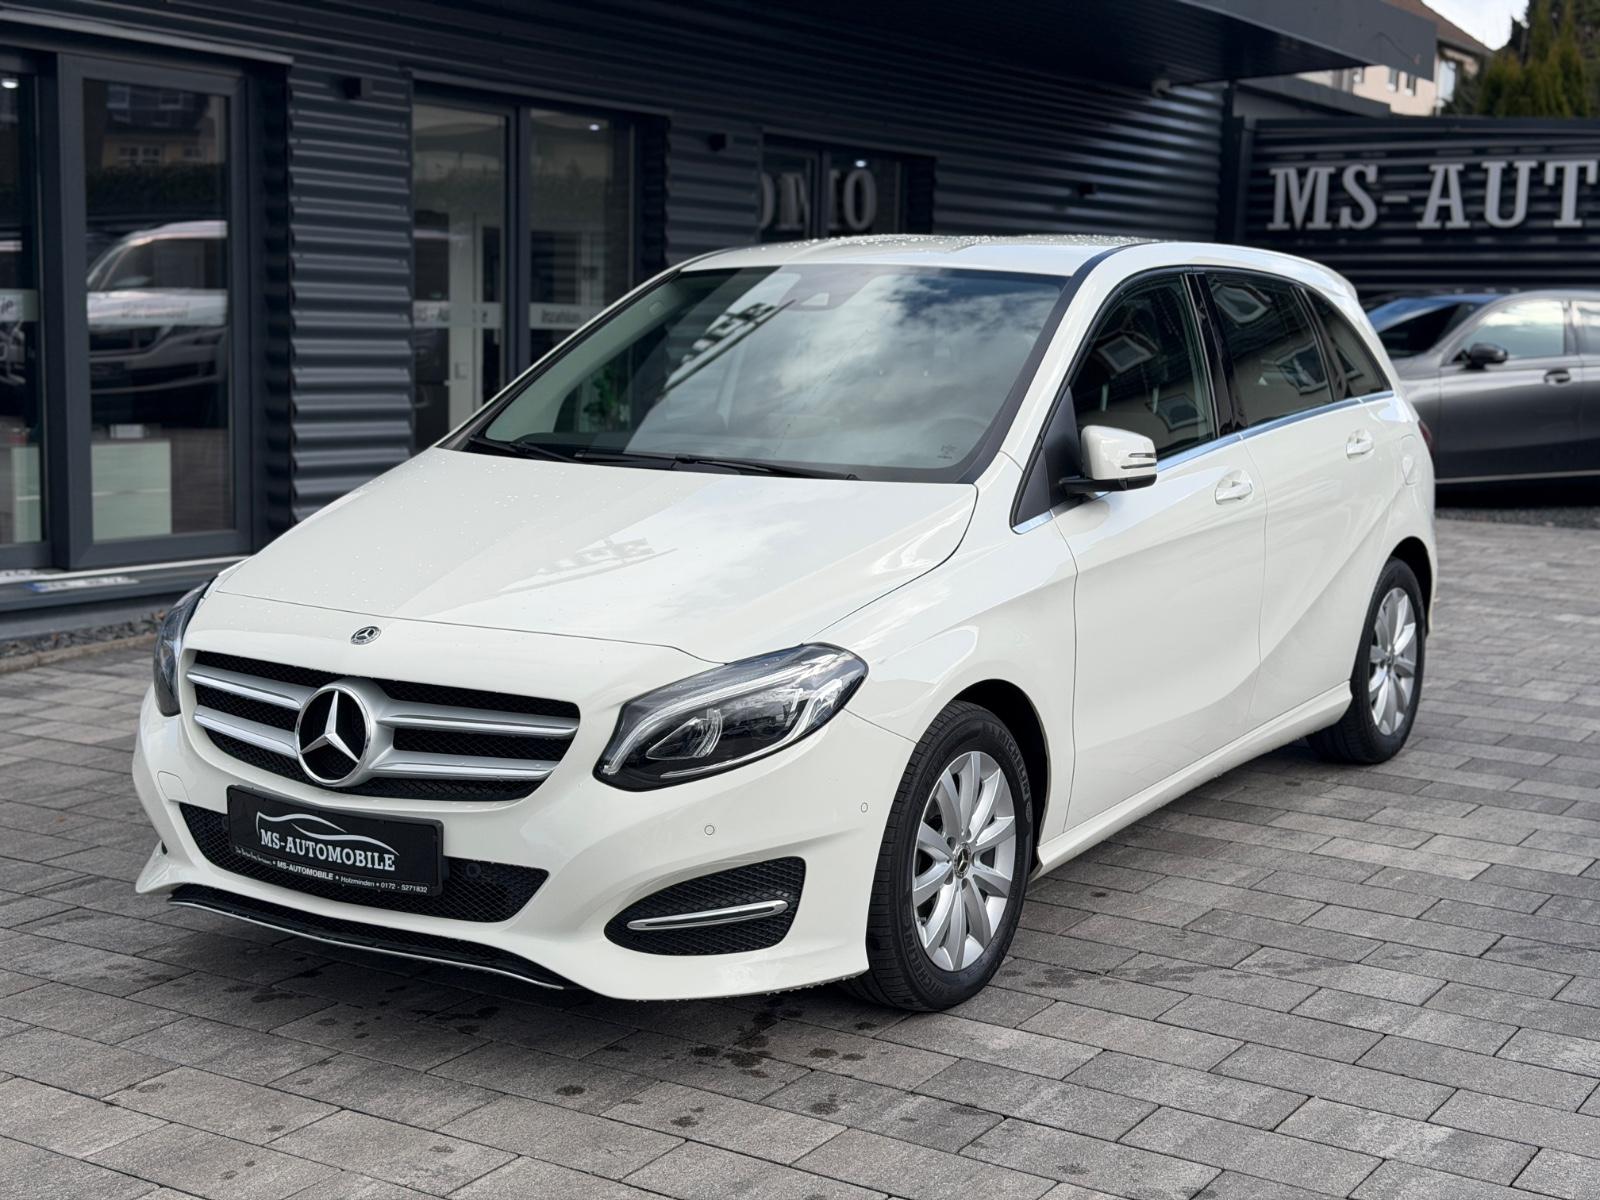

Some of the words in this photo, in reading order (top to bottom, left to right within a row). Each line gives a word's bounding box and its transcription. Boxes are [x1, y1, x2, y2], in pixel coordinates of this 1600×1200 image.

[1267, 160, 1598, 230] MS-AUT
[997, 730, 1030, 798] MICHELIN
[260, 829, 395, 871] MS-AUTOMOBILE
[277, 862, 334, 880] MS-AUTOMOBILE
[340, 875, 375, 888] Holzminden
[380, 881, 396, 890] 0172
[903, 931, 944, 995] MICHELIN
